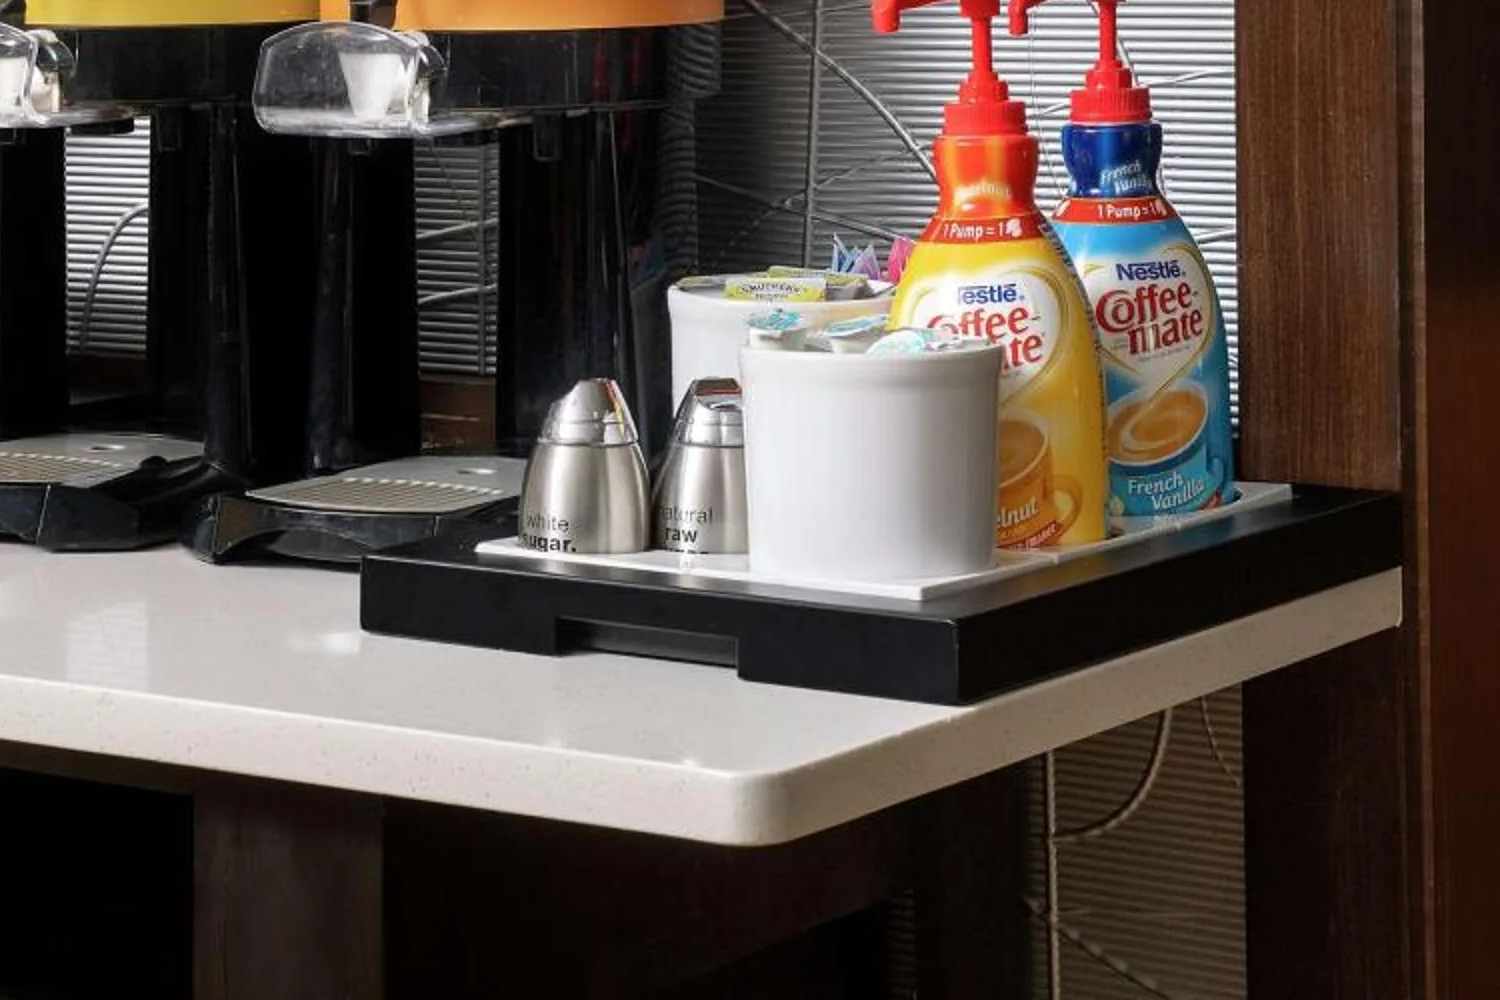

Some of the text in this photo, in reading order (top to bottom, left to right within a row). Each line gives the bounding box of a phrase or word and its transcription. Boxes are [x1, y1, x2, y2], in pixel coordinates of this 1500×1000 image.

[1106, 203, 1141, 220] Pump
[950, 222, 984, 241] Pump
[1128, 308, 1203, 355] mate
[1127, 471, 1184, 496] French
[1150, 476, 1205, 510] Vanilla
[527, 513, 570, 533] white
[664, 527, 698, 544] raw
